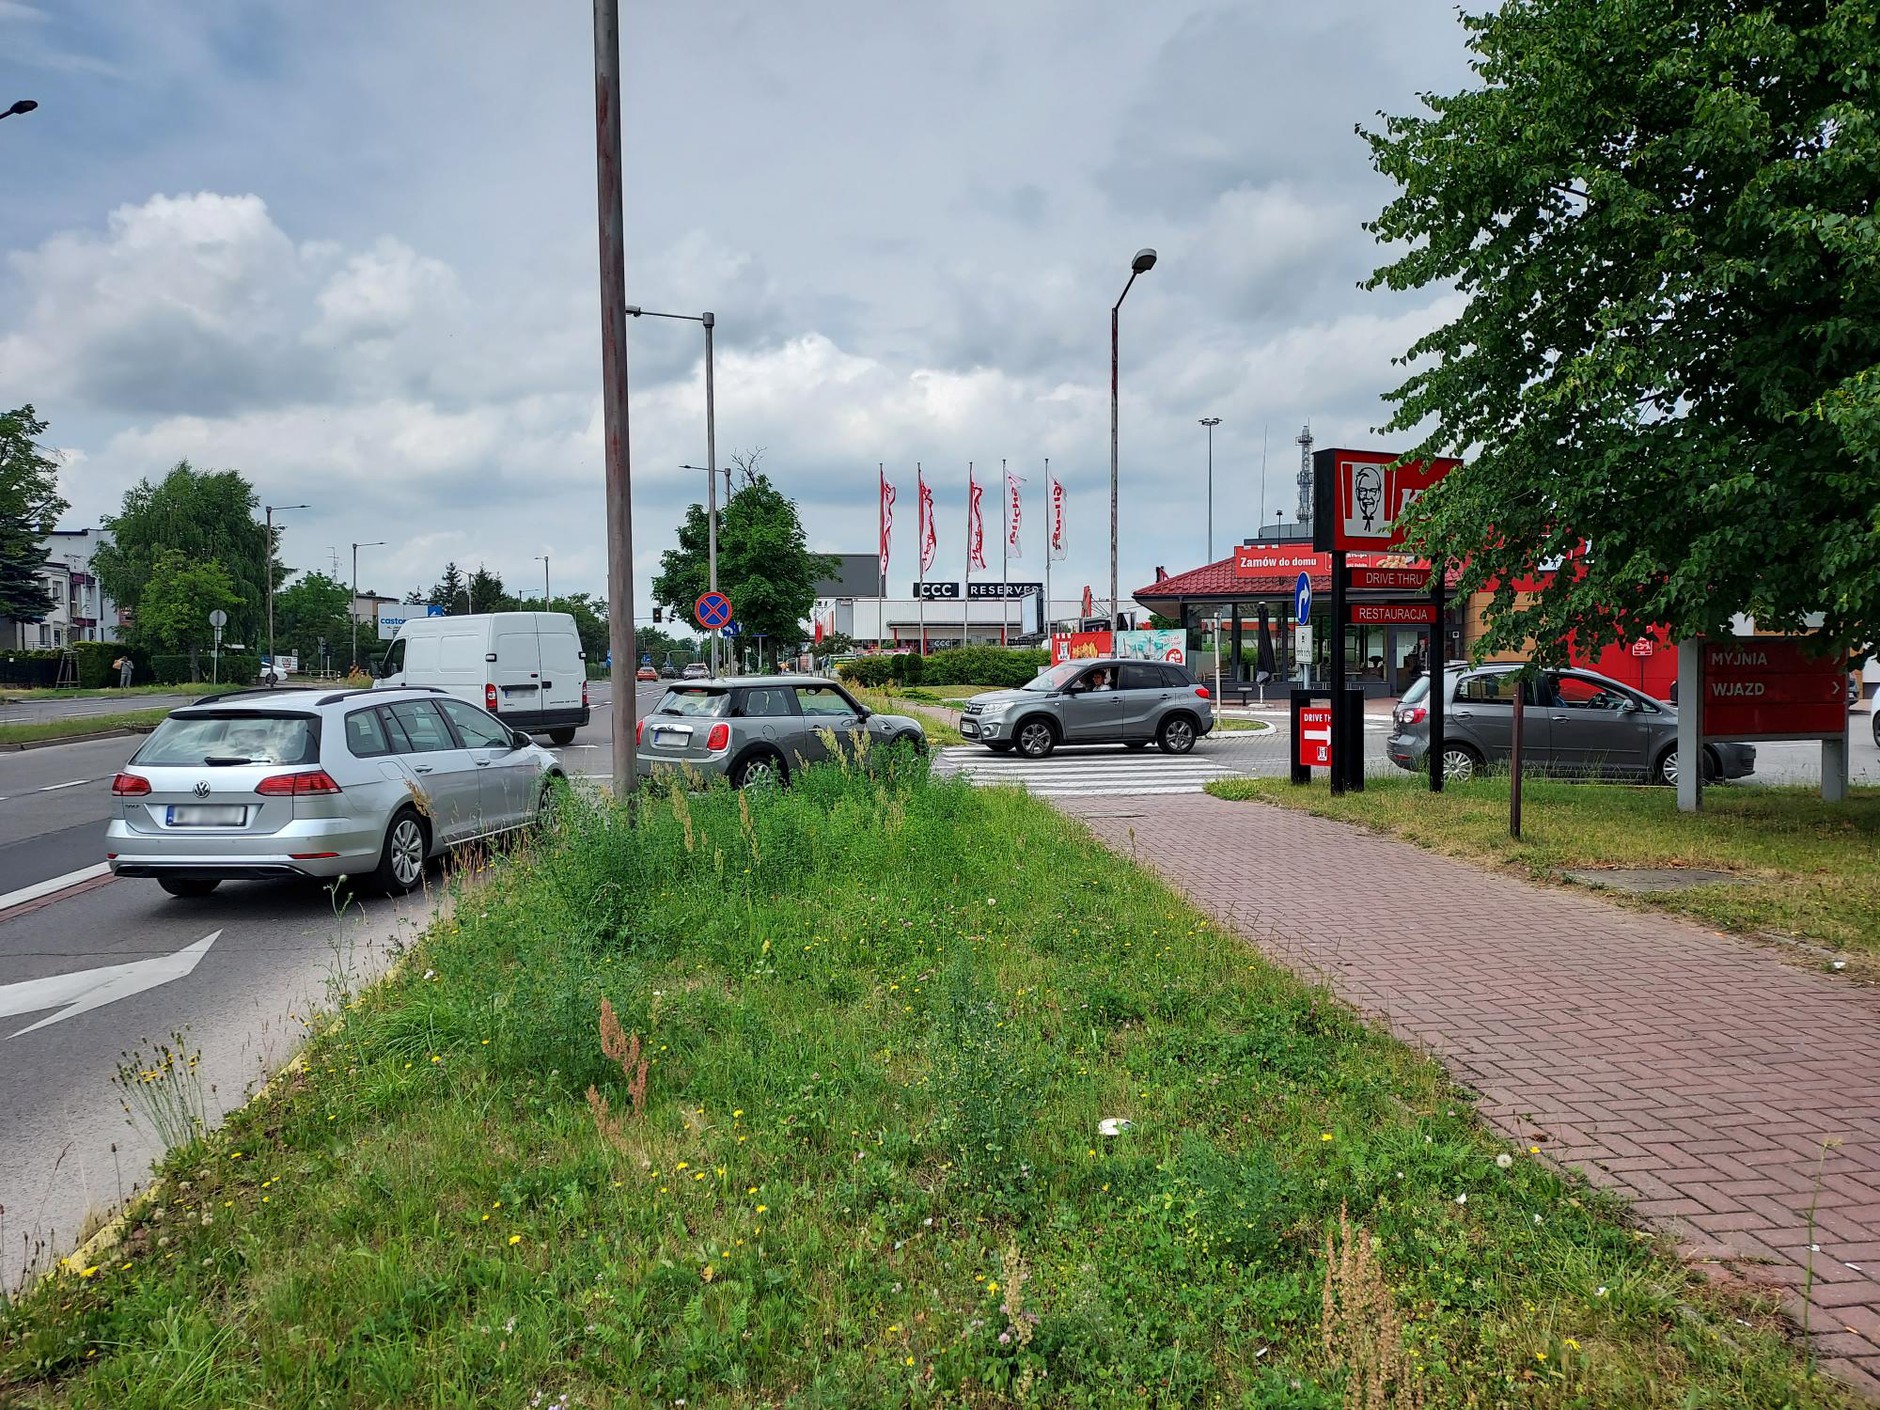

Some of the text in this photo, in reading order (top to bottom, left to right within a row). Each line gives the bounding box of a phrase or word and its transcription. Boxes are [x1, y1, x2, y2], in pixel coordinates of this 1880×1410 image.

[1240, 555, 1317, 568] Zamów do domu
[1366, 572, 1423, 585] DRIVE THRU
[921, 584, 952, 596] CCC
[1359, 607, 1428, 620] RESTAURACJA
[380, 617, 407, 625] castor
[1711, 652, 1768, 666] MYJNIA
[1712, 682, 1765, 697] WJAZD
[1304, 713, 1332, 722] DRIVE TH
